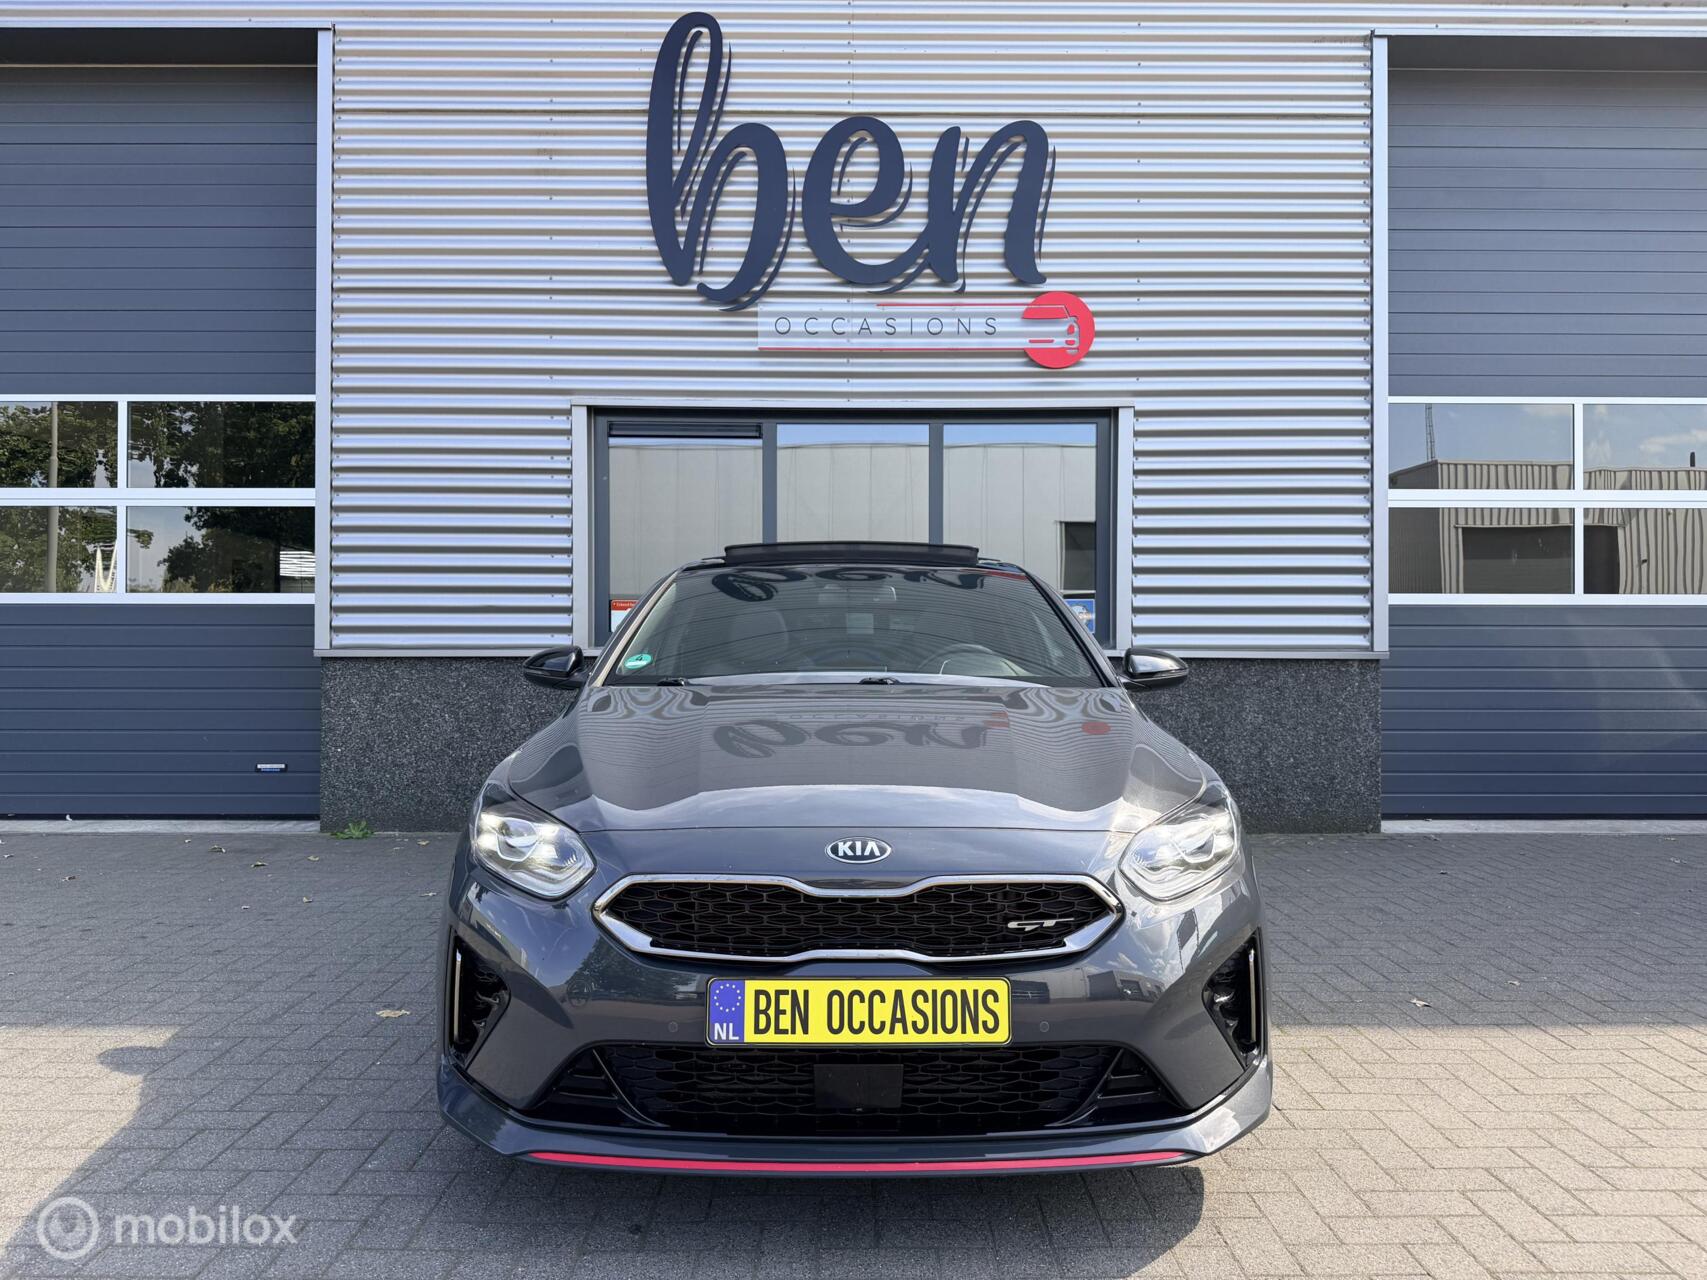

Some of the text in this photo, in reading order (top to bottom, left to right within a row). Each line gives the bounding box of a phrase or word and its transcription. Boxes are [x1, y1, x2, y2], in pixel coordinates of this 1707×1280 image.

[646, 11, 1056, 312] ben
[774, 316, 998, 336] OCCASIONS
[837, 841, 880, 857] KIA
[753, 988, 1000, 1035] BEN OCCASIONS
[713, 1022, 739, 1041] NL
